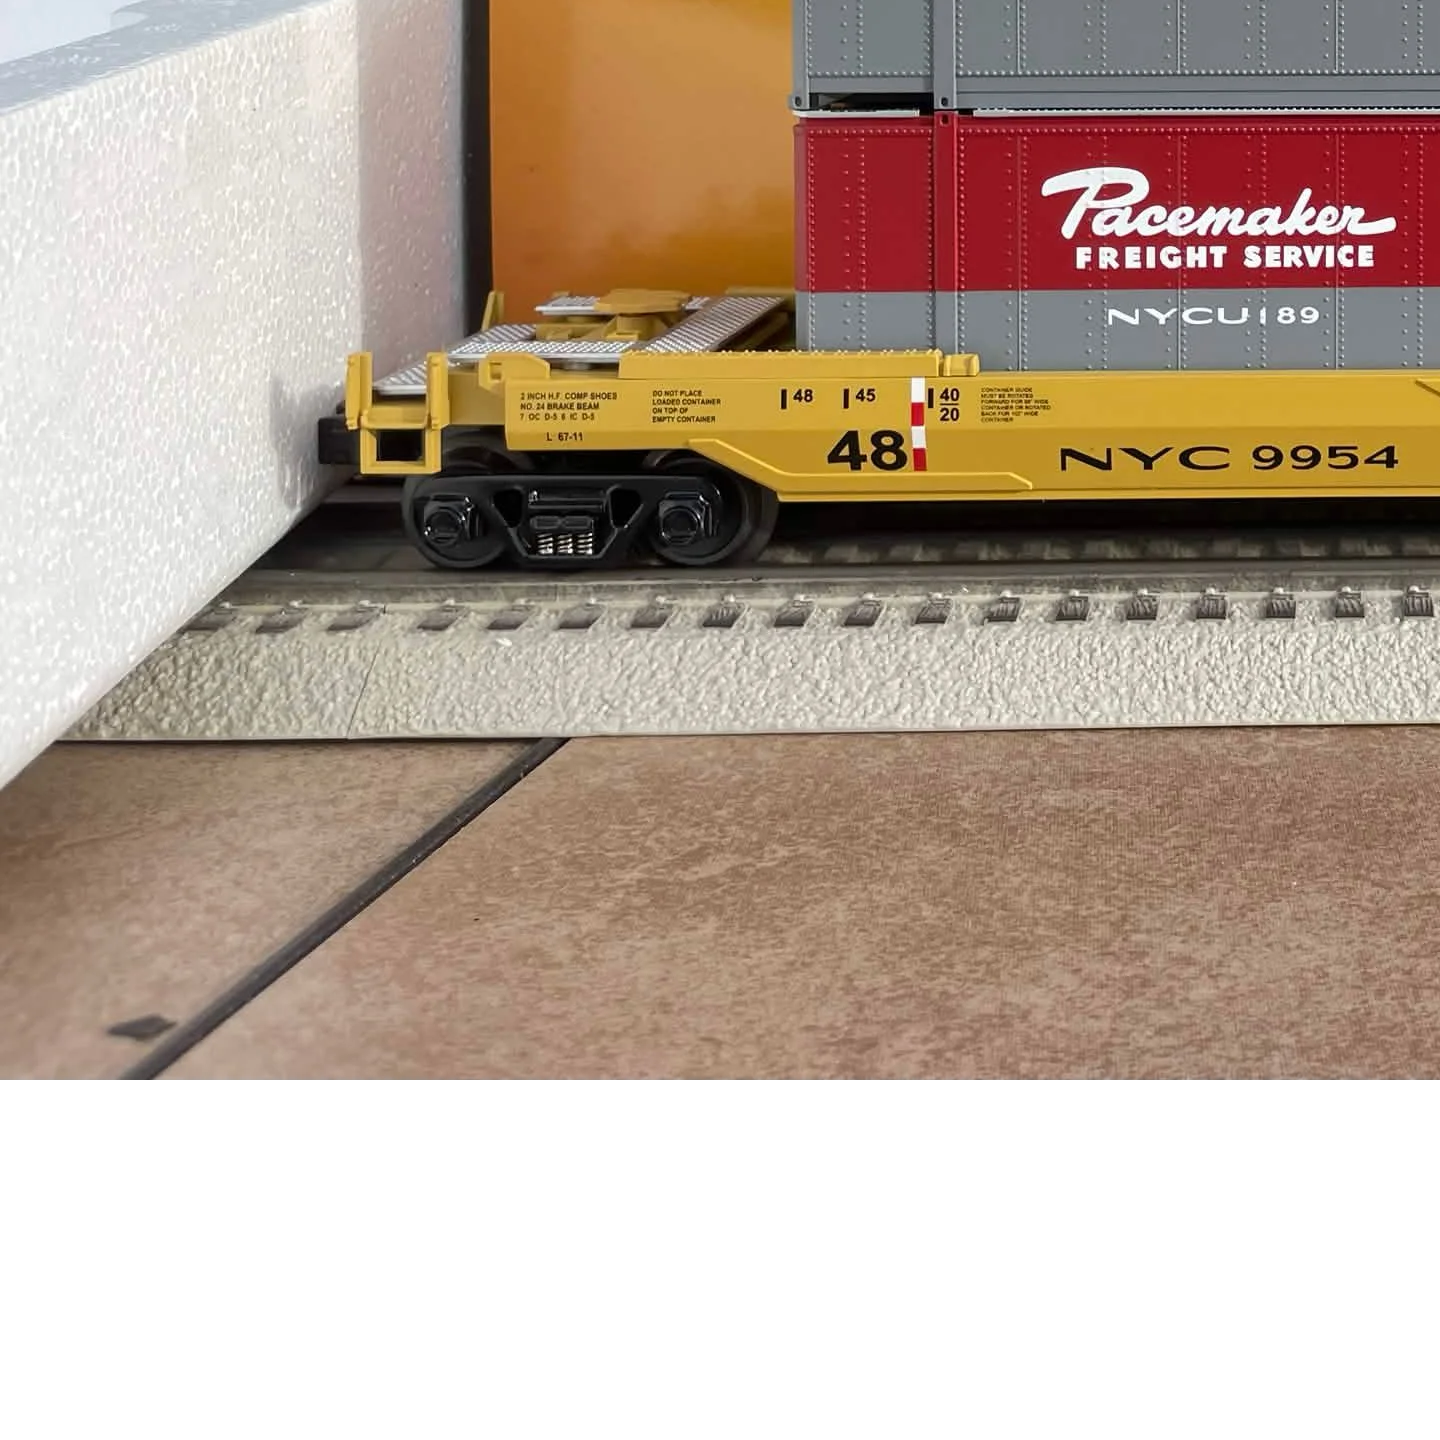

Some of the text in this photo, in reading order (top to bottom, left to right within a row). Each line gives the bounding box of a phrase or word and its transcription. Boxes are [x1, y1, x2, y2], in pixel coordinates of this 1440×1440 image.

[1040, 166, 1397, 240] Pacemaker
[1075, 244, 1375, 270] FREIGHT SERVICE
[527, 392, 546, 400] INCH
[565, 392, 588, 400] COMP
[590, 392, 617, 400] SHOES
[793, 389, 813, 402] 48
[855, 388, 876, 402] 45
[940, 388, 960, 402] 40
[536, 402, 545, 410] 24
[547, 402, 575, 410] BRAKE
[577, 402, 599, 410] BEAM
[940, 408, 960, 421] 20
[546, 432, 583, 441] L 67-11
[827, 430, 908, 471] 48
[1060, 445, 1398, 472] NYC 9954
